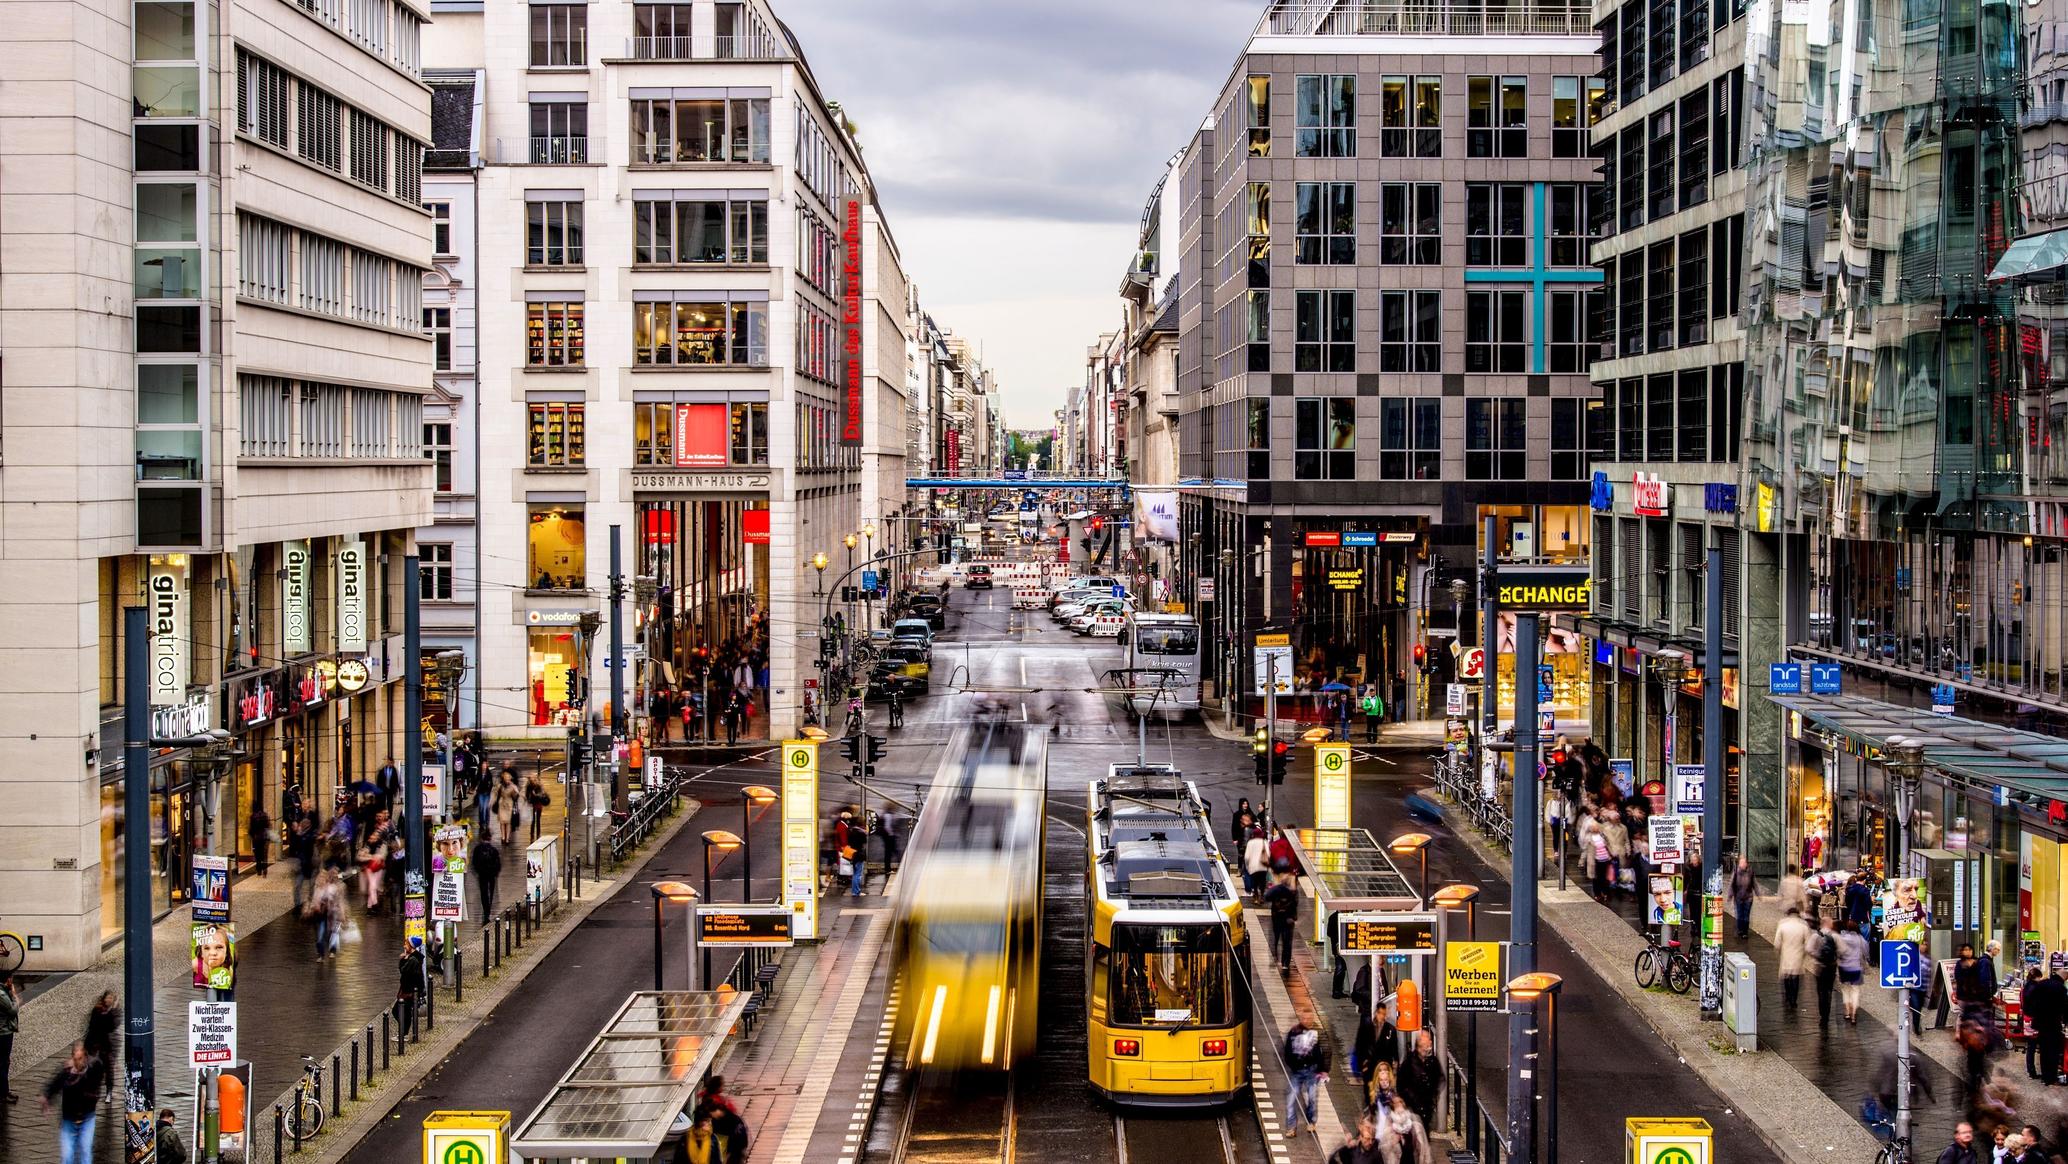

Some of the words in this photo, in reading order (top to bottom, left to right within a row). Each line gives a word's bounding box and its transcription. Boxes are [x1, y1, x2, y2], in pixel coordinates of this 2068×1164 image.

[845, 329, 859, 354] das
[844, 360, 859, 440] Dussmann
[678, 409, 688, 459] Dussmann
[633, 476, 743, 491] DUSSMANN-HAUS
[193, 927, 216, 938] HELLO
[1897, 952, 1911, 975] P
[1448, 969, 1496, 979] Werben
[1448, 985, 1496, 994] Laternen!
[195, 1006, 210, 1014] Nicht
[211, 1006, 230, 1016] länger
[201, 1015, 224, 1023] warten!
[192, 1024, 234, 1032] Zwei-Klassen-
[201, 1033, 224, 1041] Medizin
[196, 1053, 207, 1061] DIE
